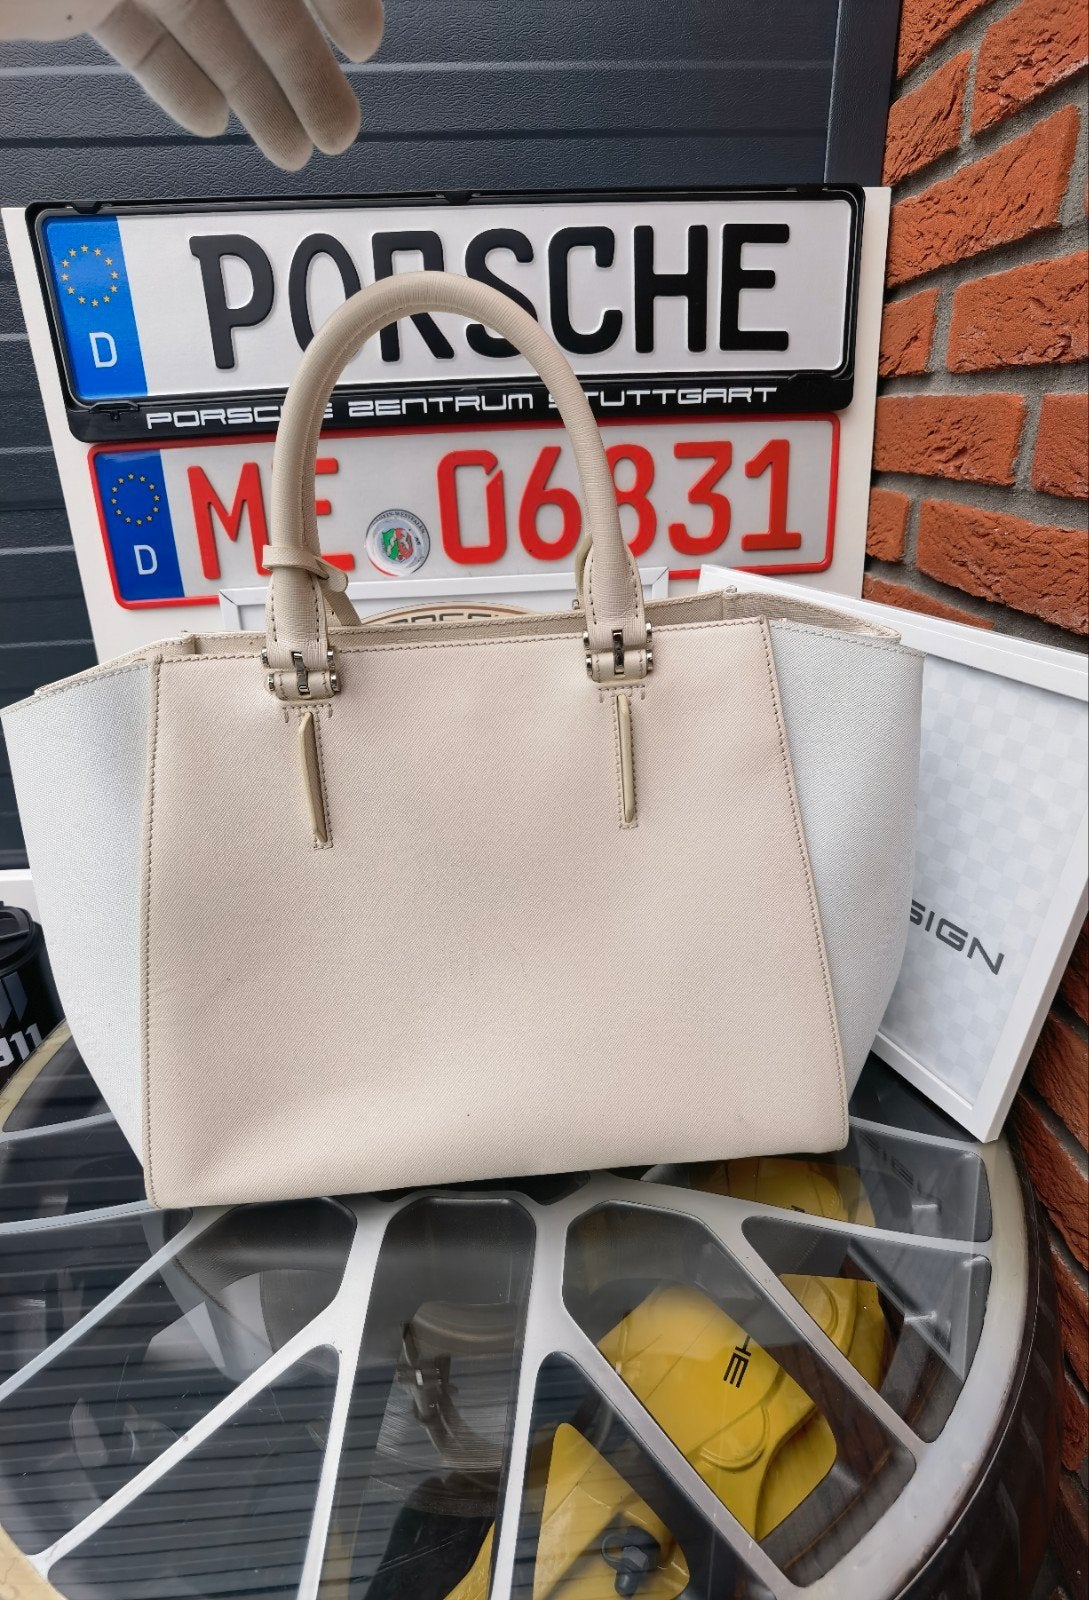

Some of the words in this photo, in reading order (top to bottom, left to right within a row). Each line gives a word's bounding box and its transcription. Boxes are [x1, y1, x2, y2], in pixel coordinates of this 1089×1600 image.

[188, 223, 790, 370] PORSCHE
[88, 331, 118, 369] D
[146, 402, 333, 429] PORSC
[348, 394, 533, 417] ZENTRUM
[437, 439, 801, 565] 06831
[134, 545, 158, 575] D
